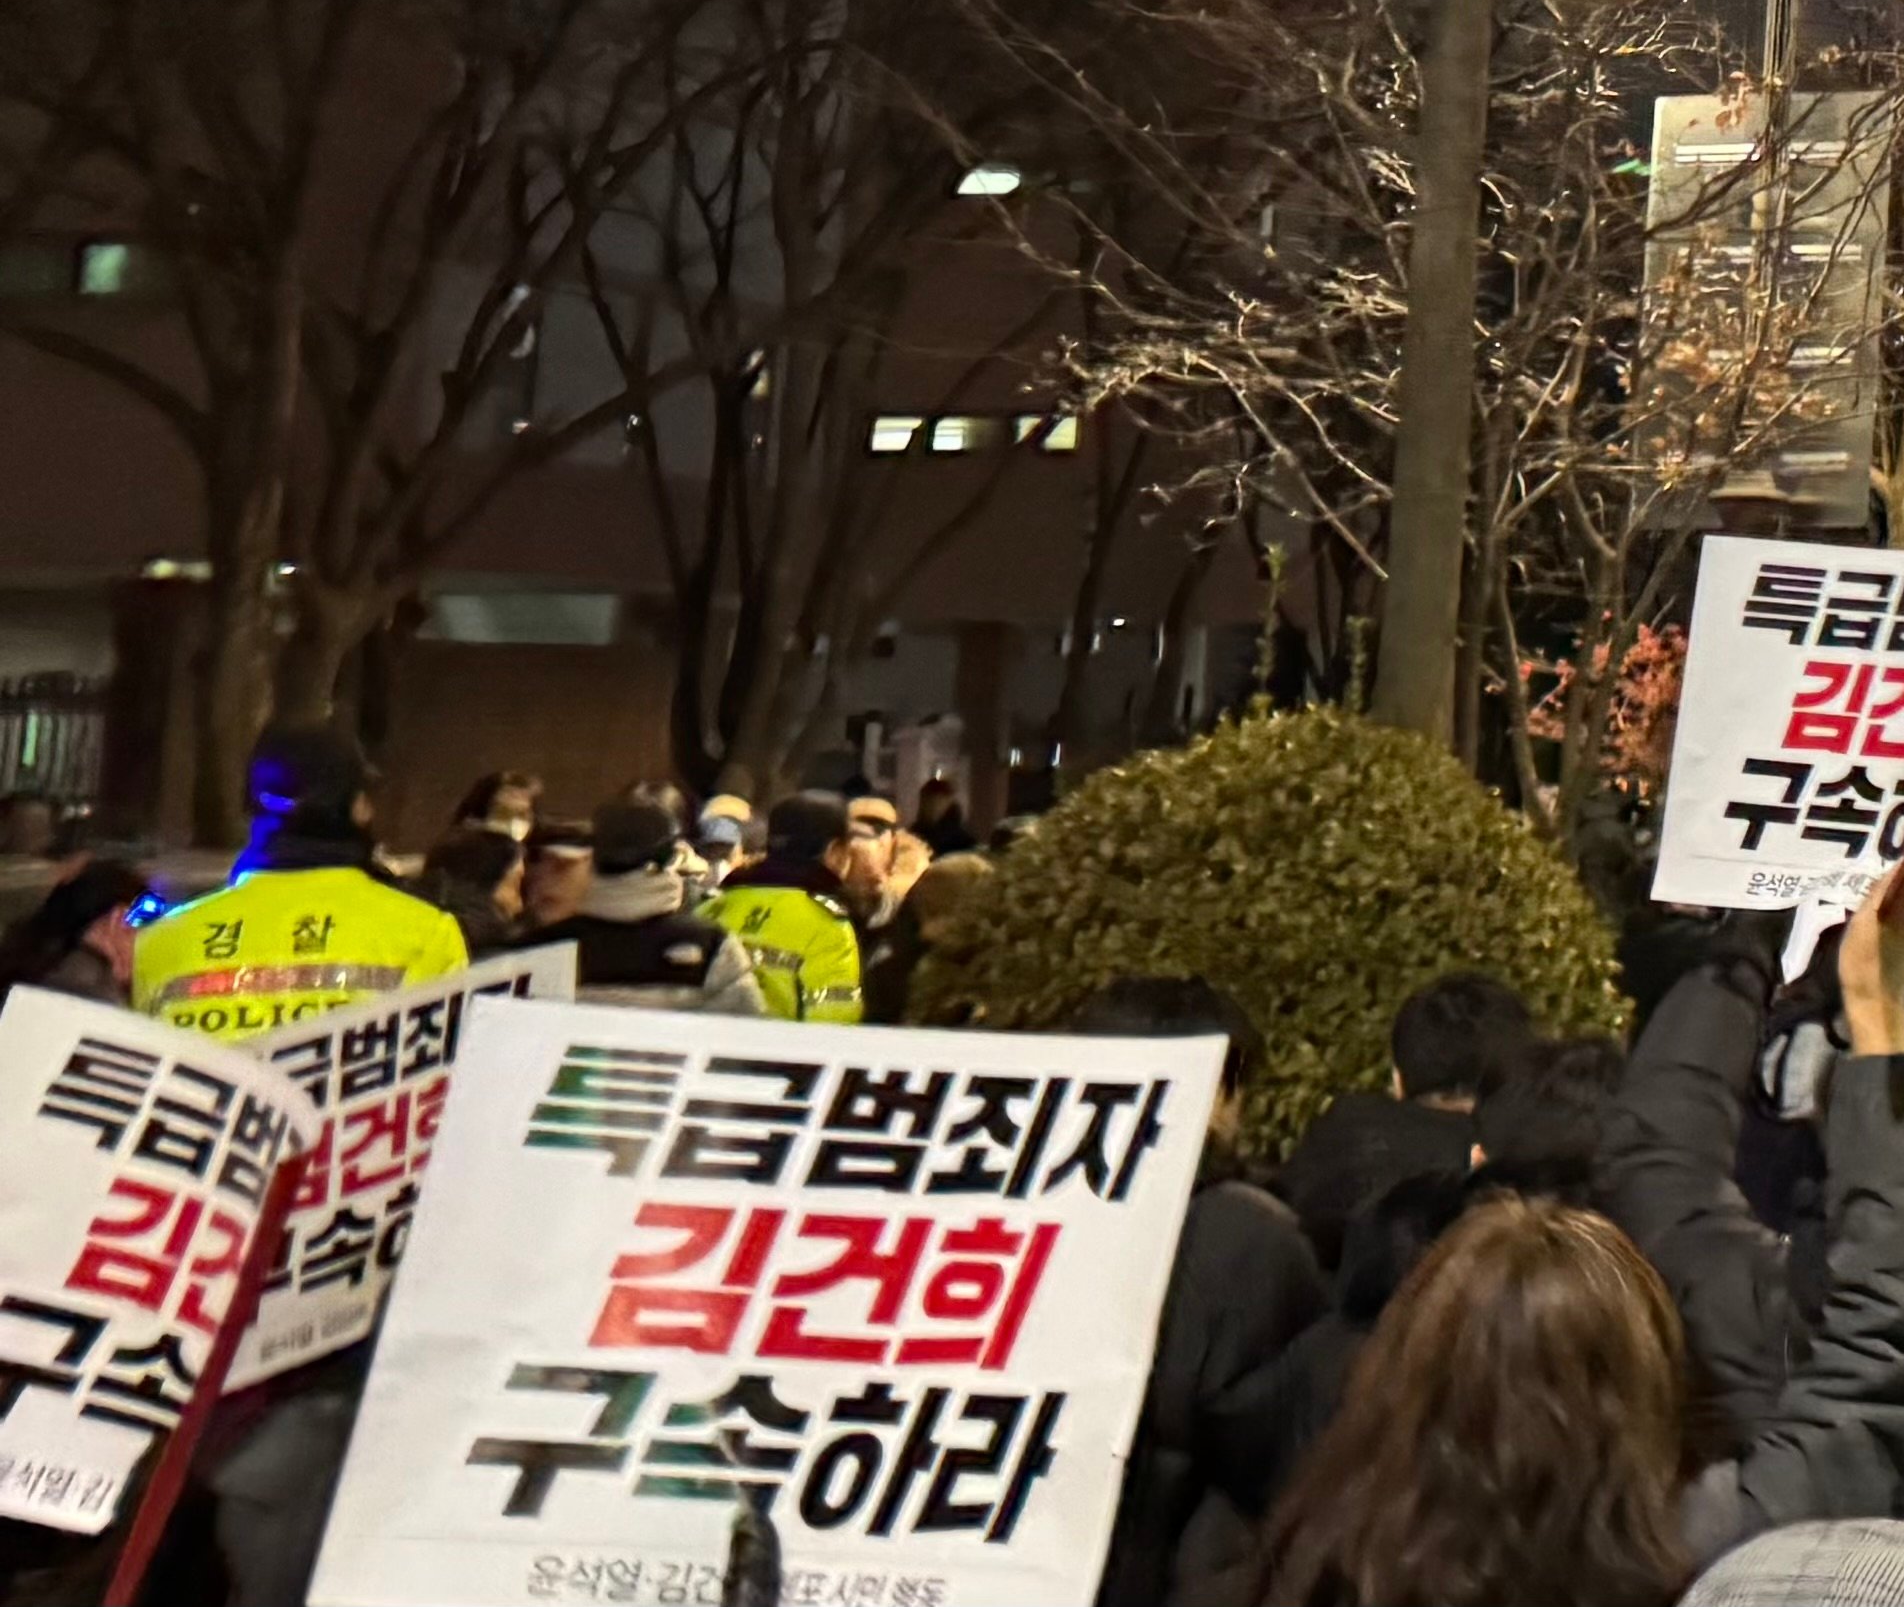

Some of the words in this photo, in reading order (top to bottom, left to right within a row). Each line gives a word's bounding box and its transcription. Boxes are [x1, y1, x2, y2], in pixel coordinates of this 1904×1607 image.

[525, 1044, 1172, 1201] 특급범죄자
[587, 1202, 1062, 1372] 김건희
[465, 1361, 1067, 1545] 구속하라
